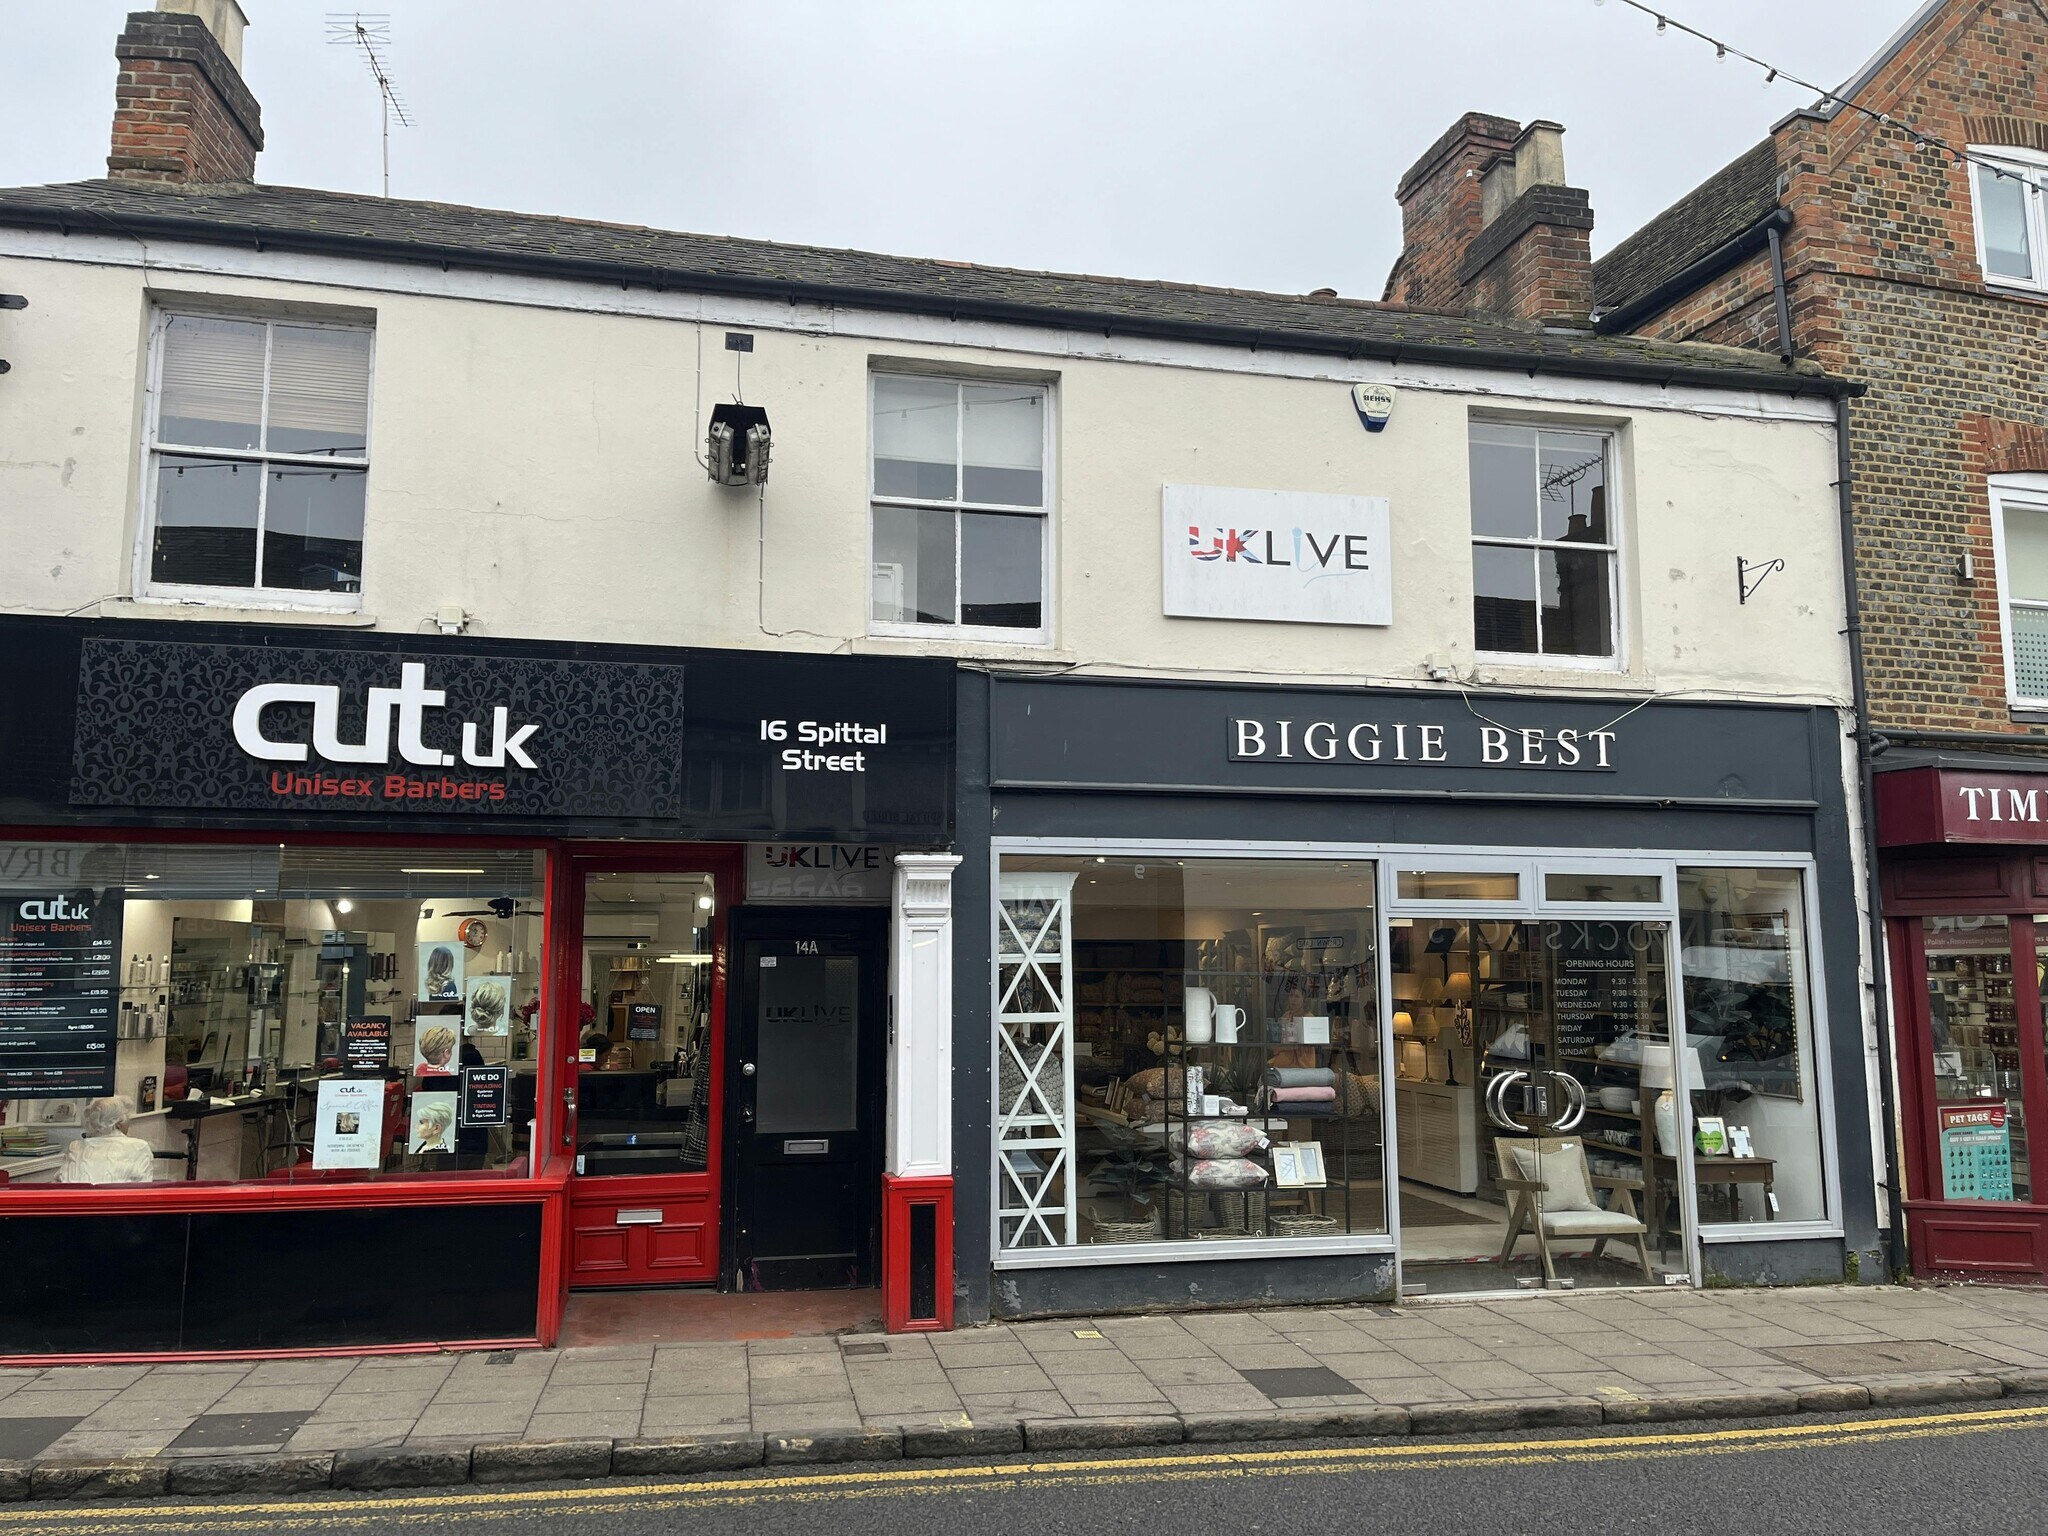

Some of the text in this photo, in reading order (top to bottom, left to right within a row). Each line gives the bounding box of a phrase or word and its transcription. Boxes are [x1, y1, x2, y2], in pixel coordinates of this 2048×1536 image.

[760, 720, 887, 748] 16 Spittal
[1236, 720, 1616, 767] BIGGIE BEST
[782, 749, 866, 772] Street
[271, 771, 506, 800] Unisex Barbers
[1959, 786, 2048, 822] TIM
[766, 845, 880, 868] UKLIVE
[10, 923, 92, 932] Unisex Barbers
[795, 940, 818, 954] 14A
[1566, 960, 1604, 968] OPENING
[1950, 1115, 1965, 1123] PET
[1967, 1113, 1989, 1122] TAGS
